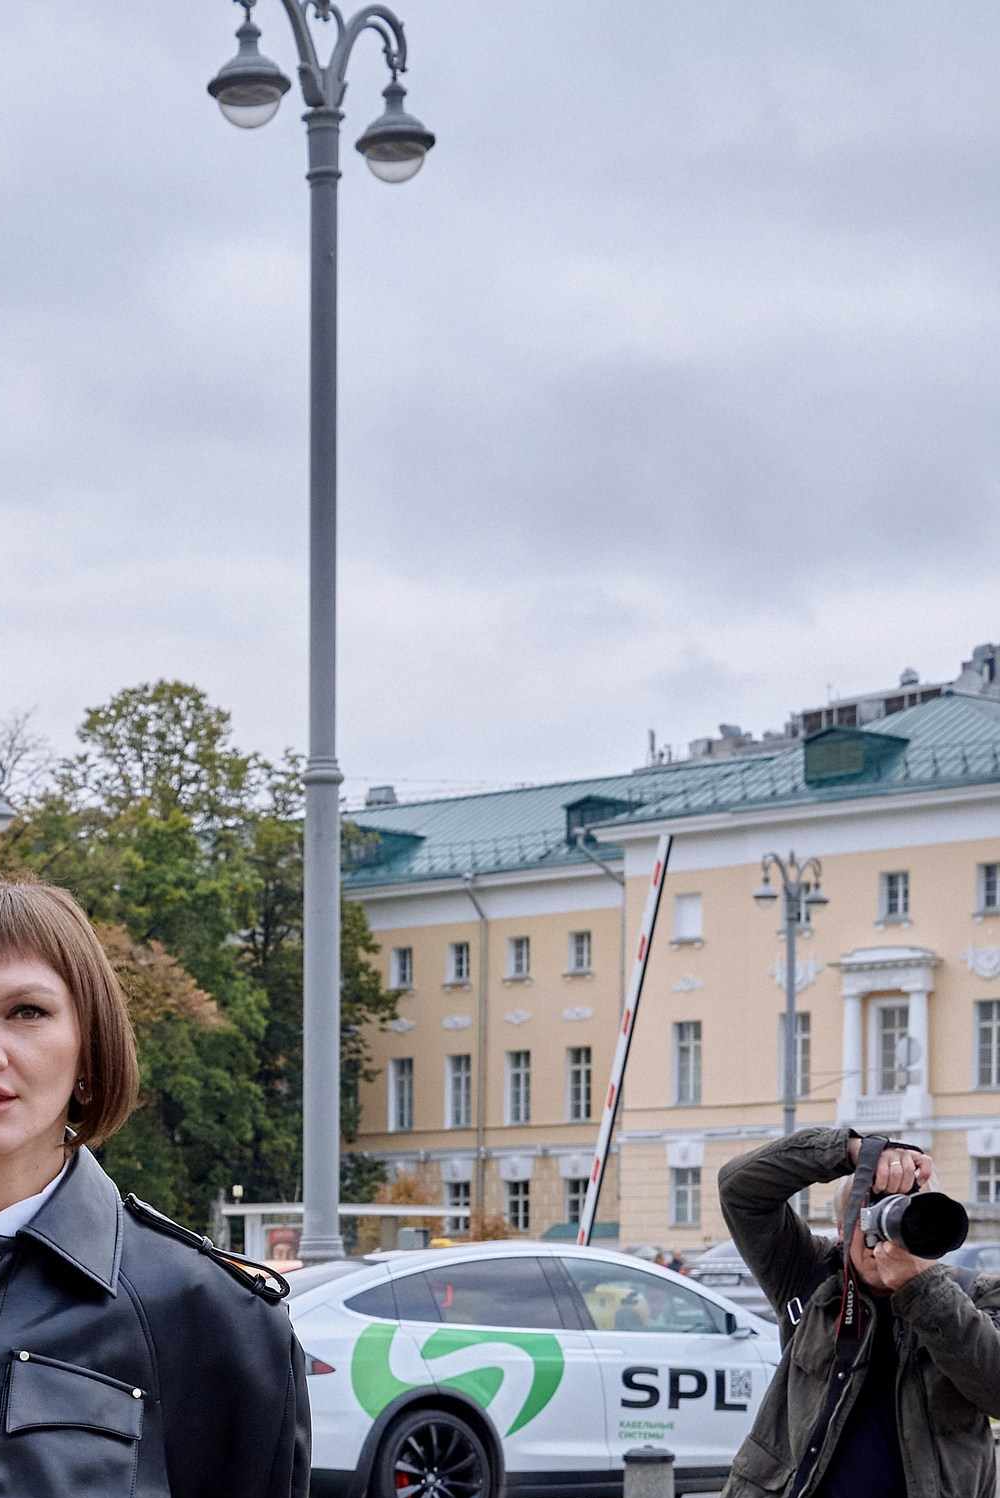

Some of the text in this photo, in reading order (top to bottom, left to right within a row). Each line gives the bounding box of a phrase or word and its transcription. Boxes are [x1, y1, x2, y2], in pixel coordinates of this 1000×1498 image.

[844, 1279, 854, 1325] Canon
[621, 1366, 748, 1411] SPL
[618, 1431, 665, 1439] СИСТЕМЫ
[619, 1421, 675, 1430] КАБЕЛЬНЫЕ
